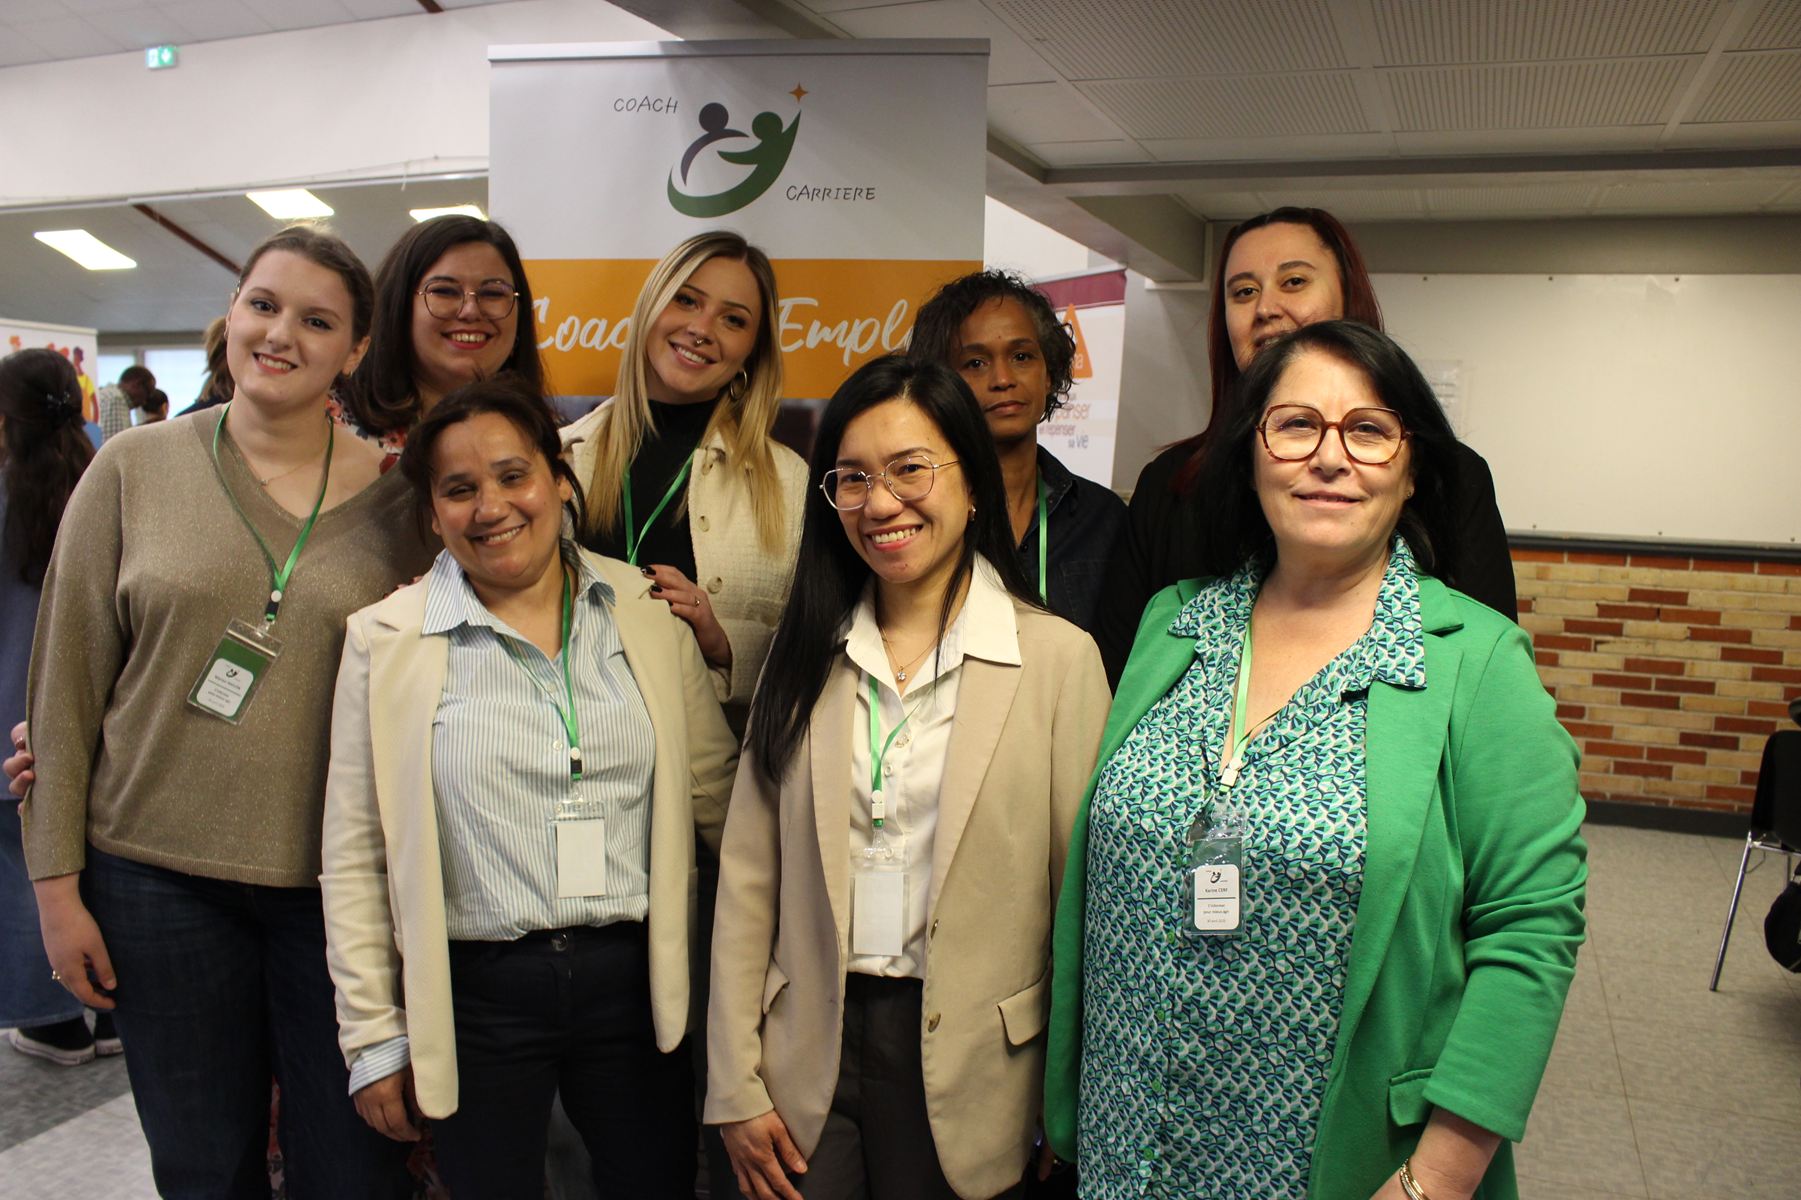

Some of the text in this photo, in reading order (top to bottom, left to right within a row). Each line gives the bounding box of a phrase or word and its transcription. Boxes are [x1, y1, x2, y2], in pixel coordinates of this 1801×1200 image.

[613, 95, 679, 114] COACH
[786, 184, 877, 201] CARRIERE
[778, 296, 914, 367] Empl
